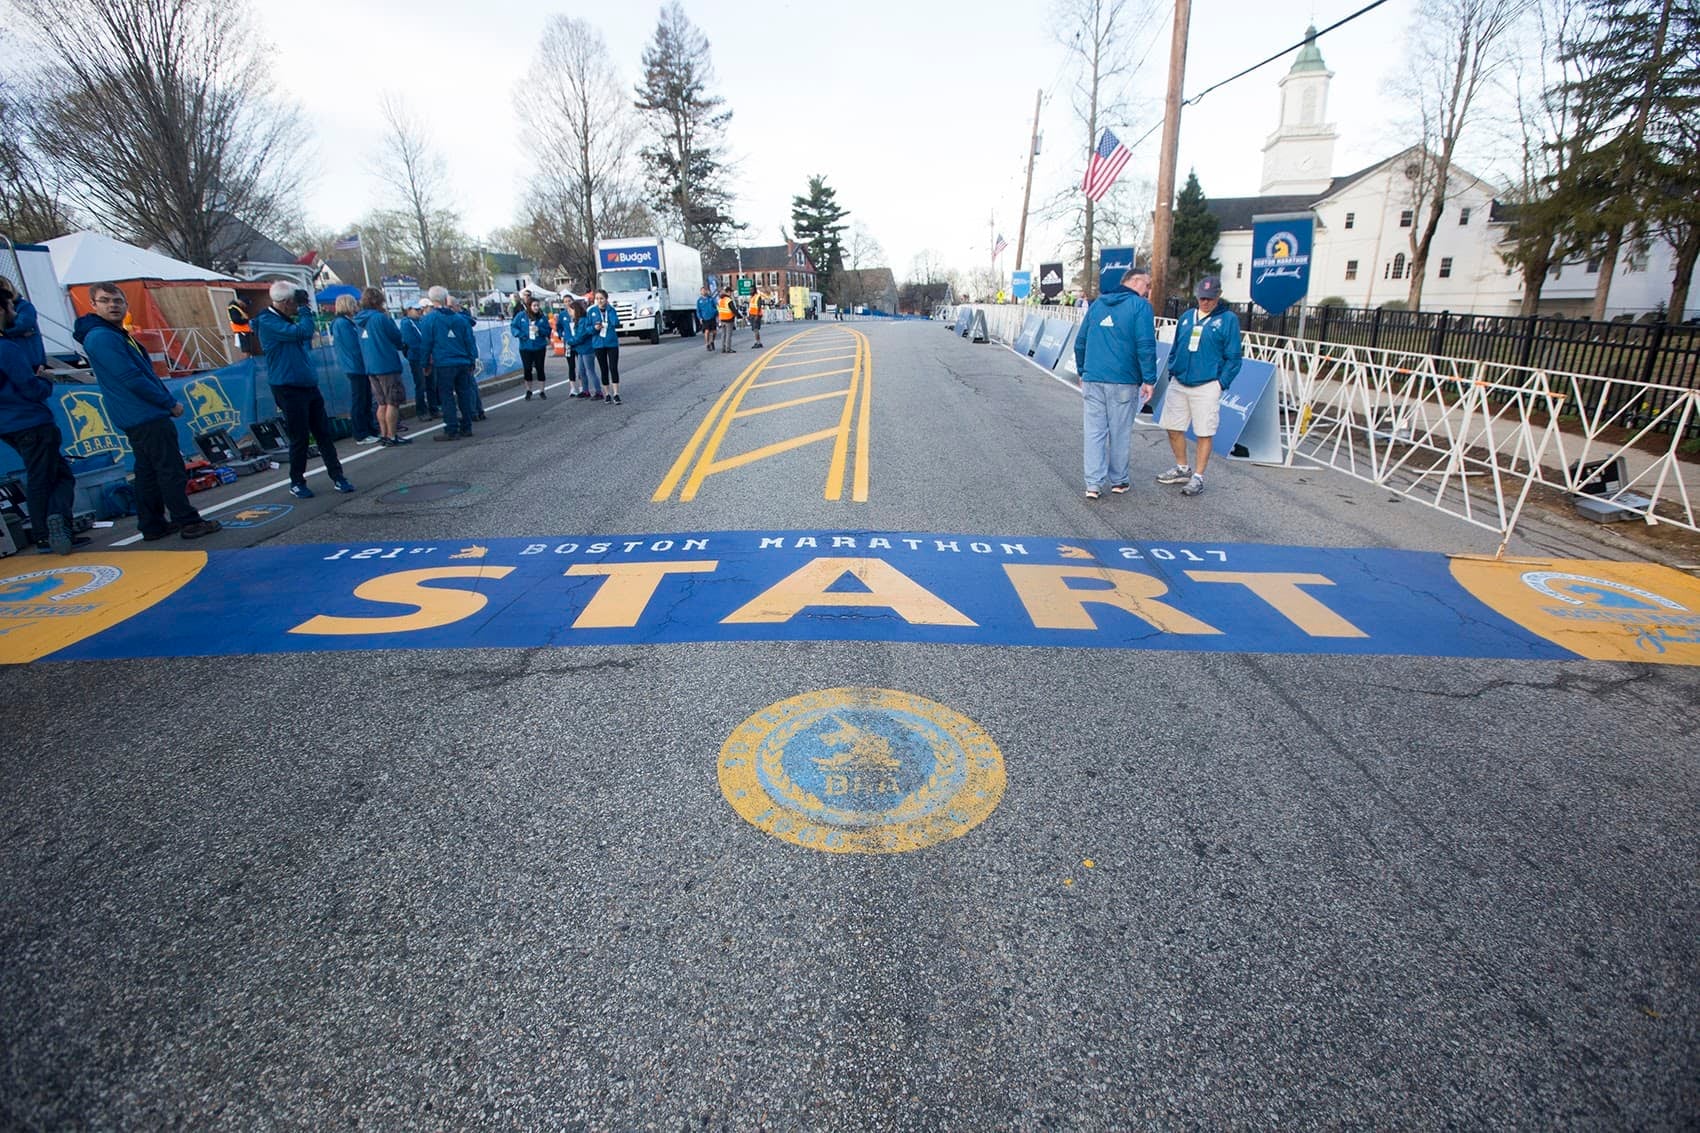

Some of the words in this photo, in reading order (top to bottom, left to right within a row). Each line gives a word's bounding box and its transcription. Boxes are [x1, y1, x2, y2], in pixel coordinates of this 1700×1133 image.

[619, 252, 652, 264] Budget
[83, 438, 118, 453] B.A.A.
[518, 538, 708, 556] BOSTON
[758, 536, 1029, 555] MARATHON
[1118, 547, 1227, 562] 2017
[287, 557, 1371, 638] START
